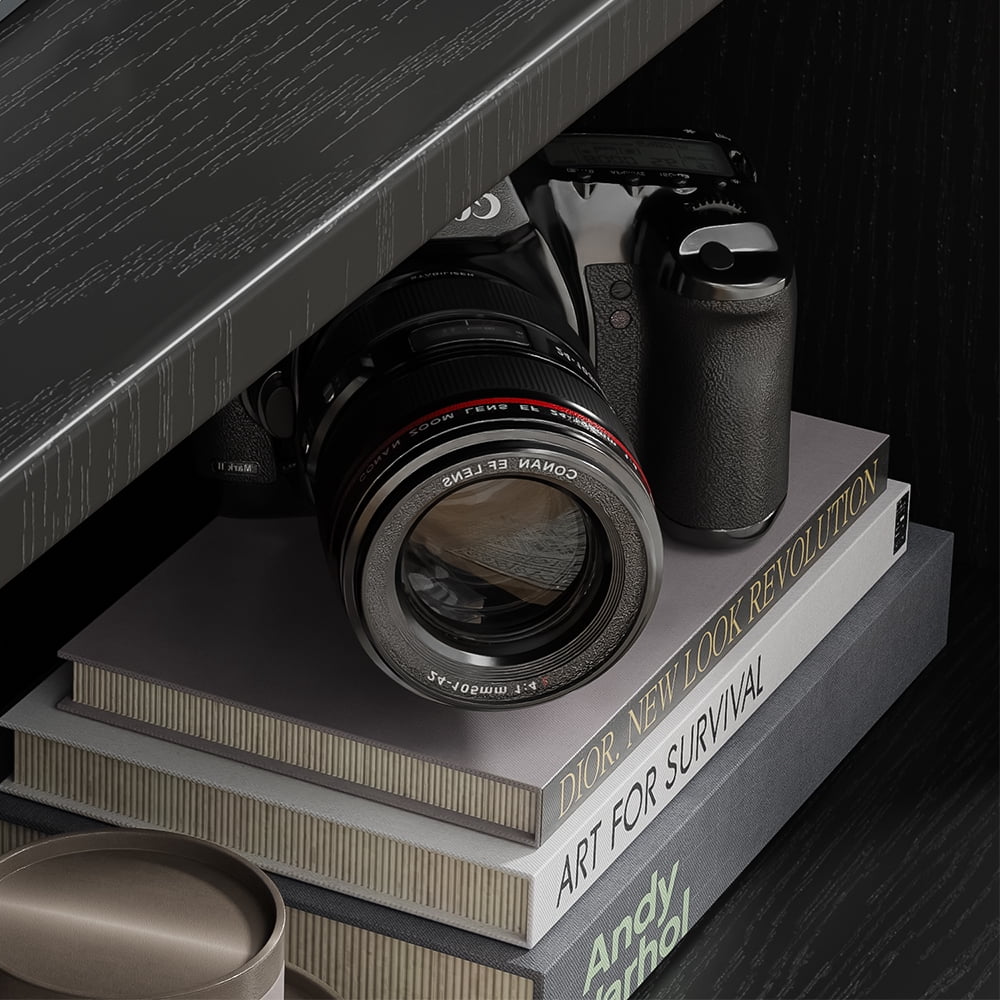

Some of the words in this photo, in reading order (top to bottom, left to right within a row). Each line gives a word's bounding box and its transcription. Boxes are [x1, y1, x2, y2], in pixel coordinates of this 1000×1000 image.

[559, 729, 621, 820] DIOR.
[626, 661, 685, 752] NEW
[682, 602, 747, 688] LOOK
[748, 458, 883, 626] REVOLUTION
[556, 819, 604, 909] ART
[610, 765, 657, 851] FOR
[665, 654, 765, 792] SURVIVAL
[583, 859, 679, 997] Andy
[595, 887, 691, 1000] arhol
